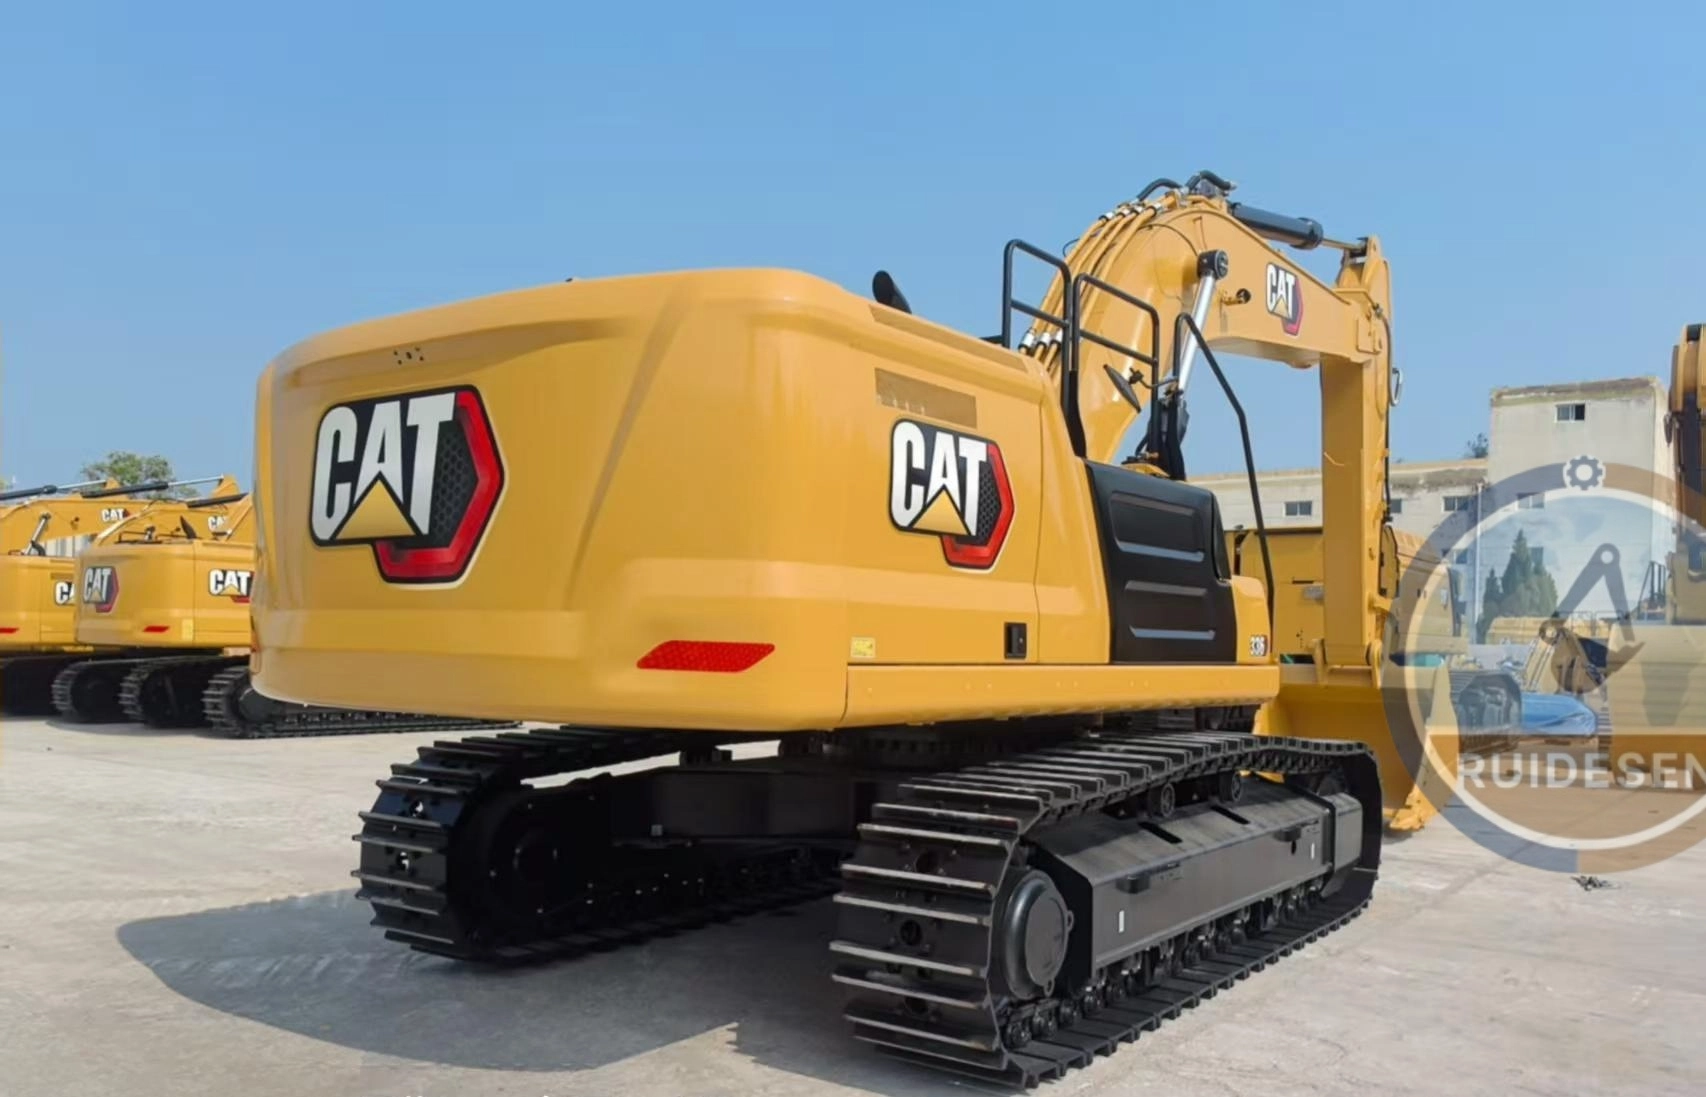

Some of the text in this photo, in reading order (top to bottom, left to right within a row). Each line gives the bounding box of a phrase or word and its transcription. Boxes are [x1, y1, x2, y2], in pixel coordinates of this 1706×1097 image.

[1267, 263, 1296, 319] CAT
[312, 392, 456, 541] CAT
[891, 420, 988, 537] CAT
[102, 508, 125, 522] CAT
[83, 567, 112, 602] CAT
[209, 569, 251, 596] CAT
